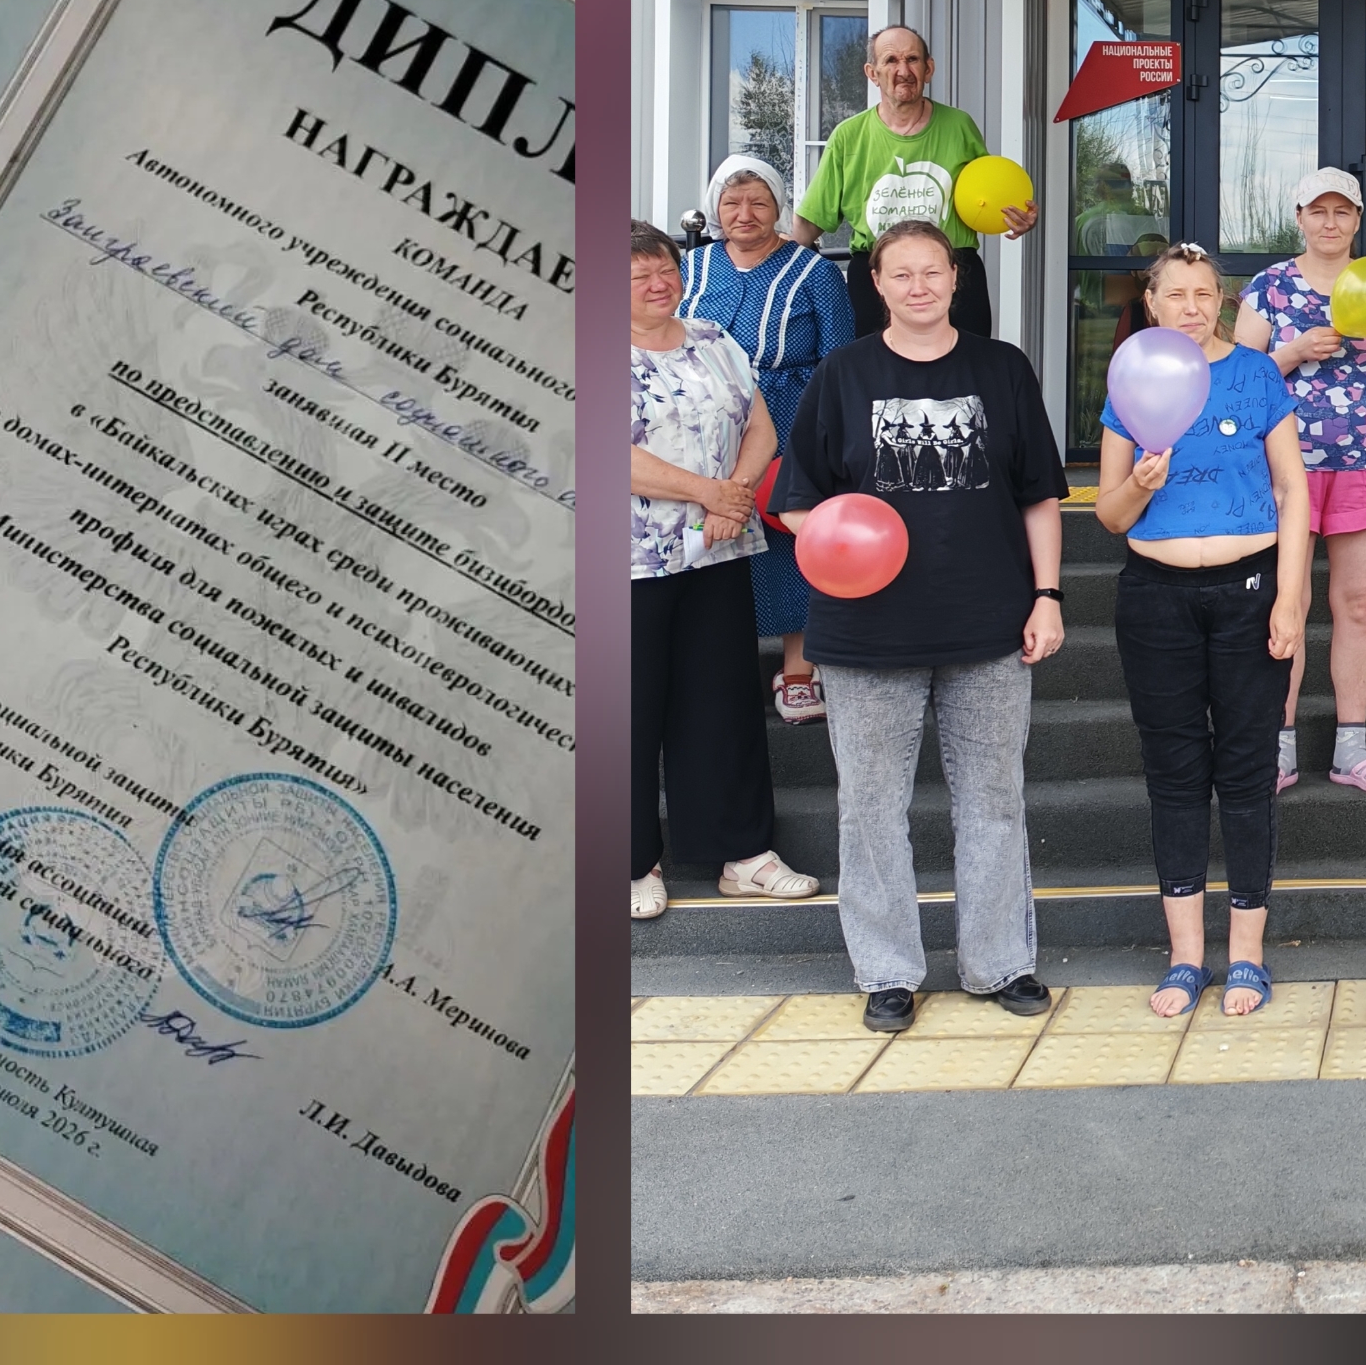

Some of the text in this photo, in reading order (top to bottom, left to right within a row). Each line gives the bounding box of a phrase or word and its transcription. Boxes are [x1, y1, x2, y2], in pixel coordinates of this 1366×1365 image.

[1102, 45, 1173, 57] НАЦИОНАЛЬНЫЕ
[1133, 59, 1173, 69] ПРОЕКТЫ
[1140, 71, 1173, 82] РОССИИ
[125, 148, 575, 402] Автономного учреждения социального
[393, 237, 529, 321] КОМАНДА
[271, 335, 346, 386] дом
[110, 360, 143, 383] по
[144, 379, 331, 489] представлению
[333, 485, 353, 502] и
[354, 497, 451, 556] защите
[104, 768, 197, 832] защиты
[52, 1083, 160, 1158] Култушная
[298, 1099, 462, 1204] Л.И. Давыдова
